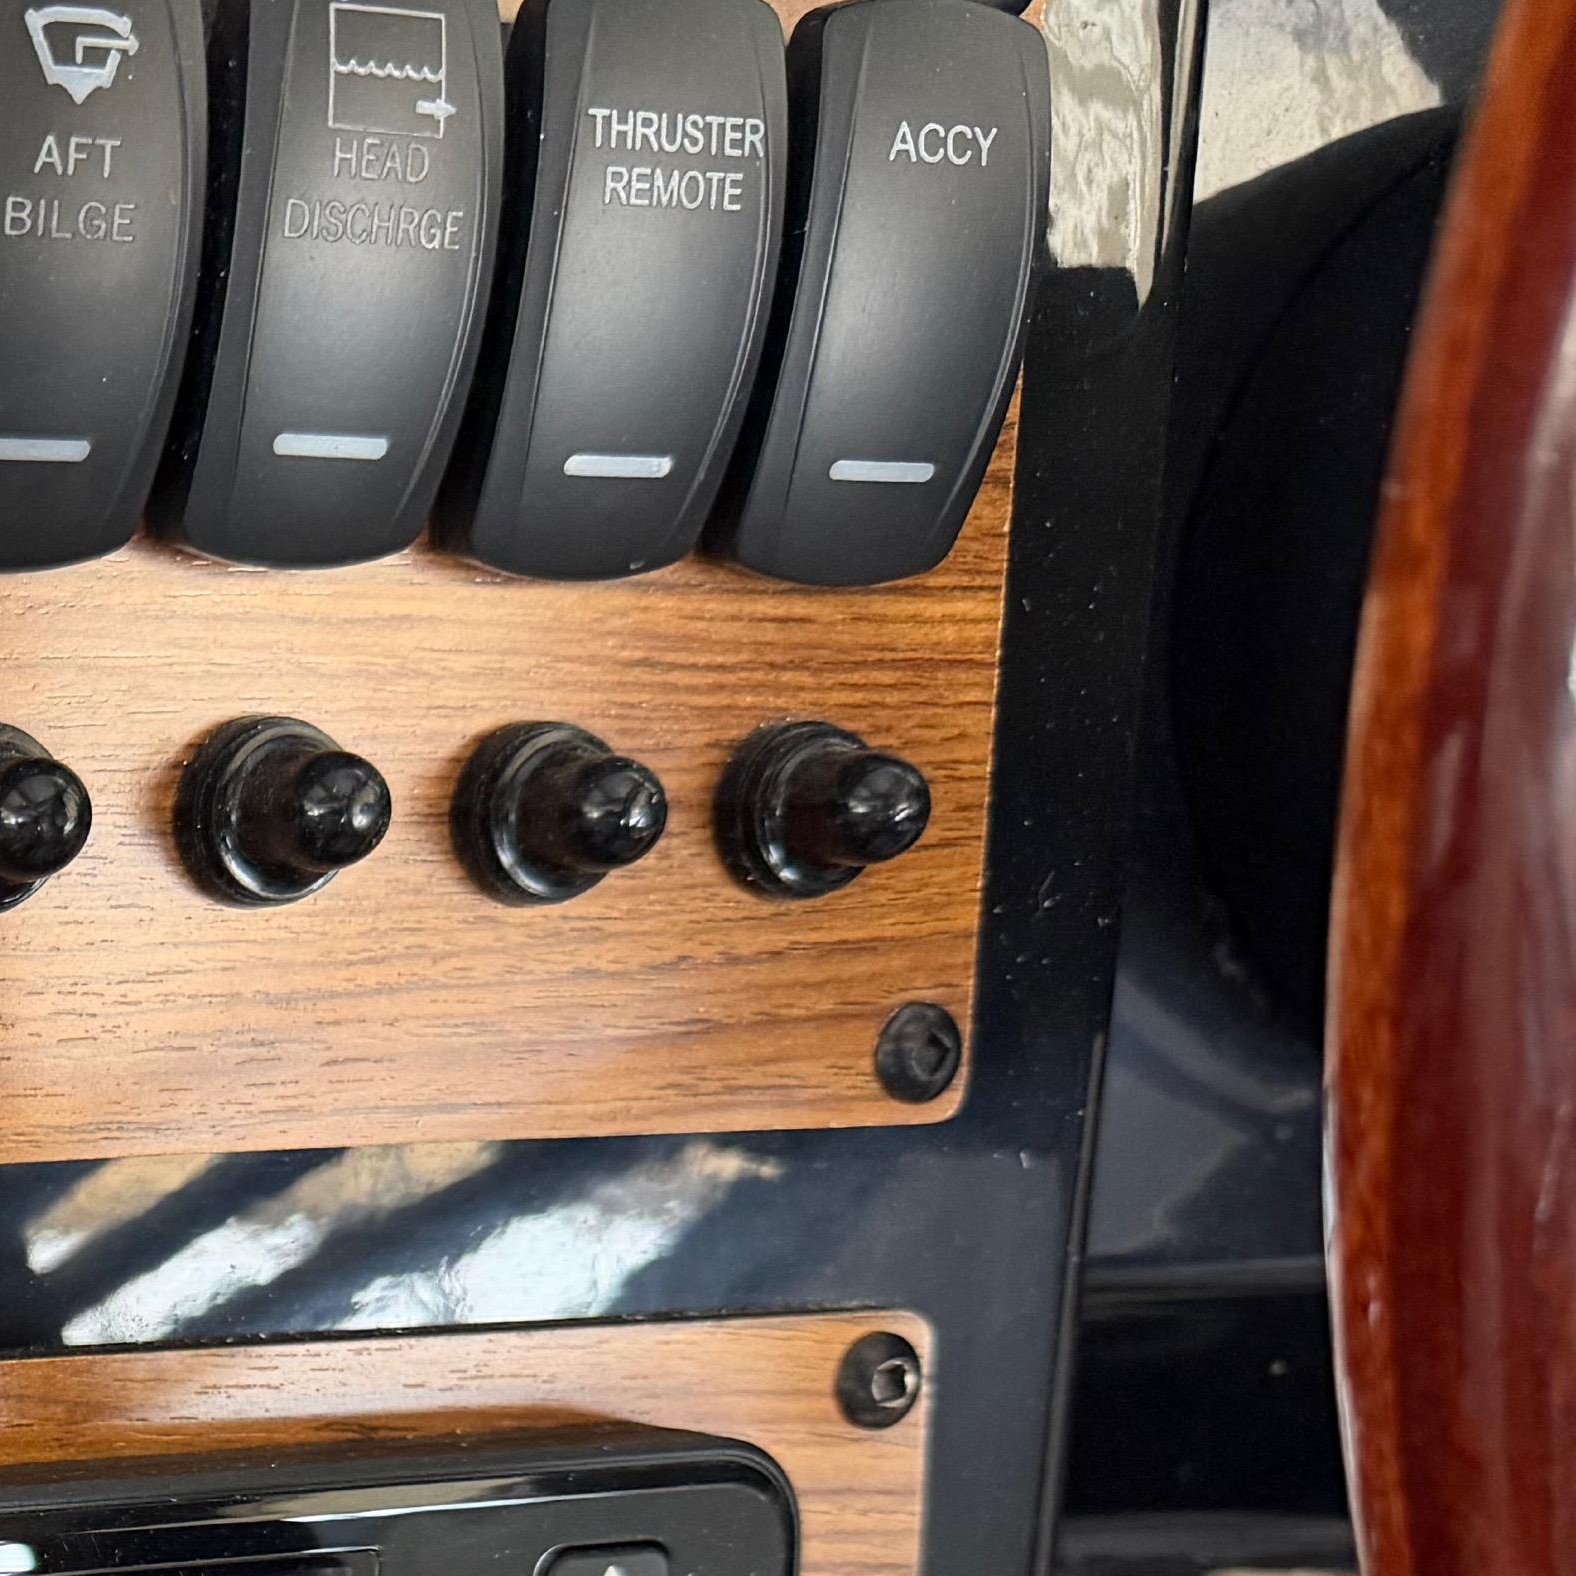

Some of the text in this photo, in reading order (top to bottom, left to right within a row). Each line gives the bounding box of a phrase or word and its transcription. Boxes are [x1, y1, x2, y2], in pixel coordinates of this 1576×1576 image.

[587, 108, 765, 158] THRUSTER
[888, 122, 998, 168] ACCY
[32, 135, 122, 178] AFT
[332, 138, 430, 184] HEAD
[603, 167, 744, 212] REMOTE
[3, 197, 135, 243] BILGE
[281, 199, 464, 252] DISCHRGE
